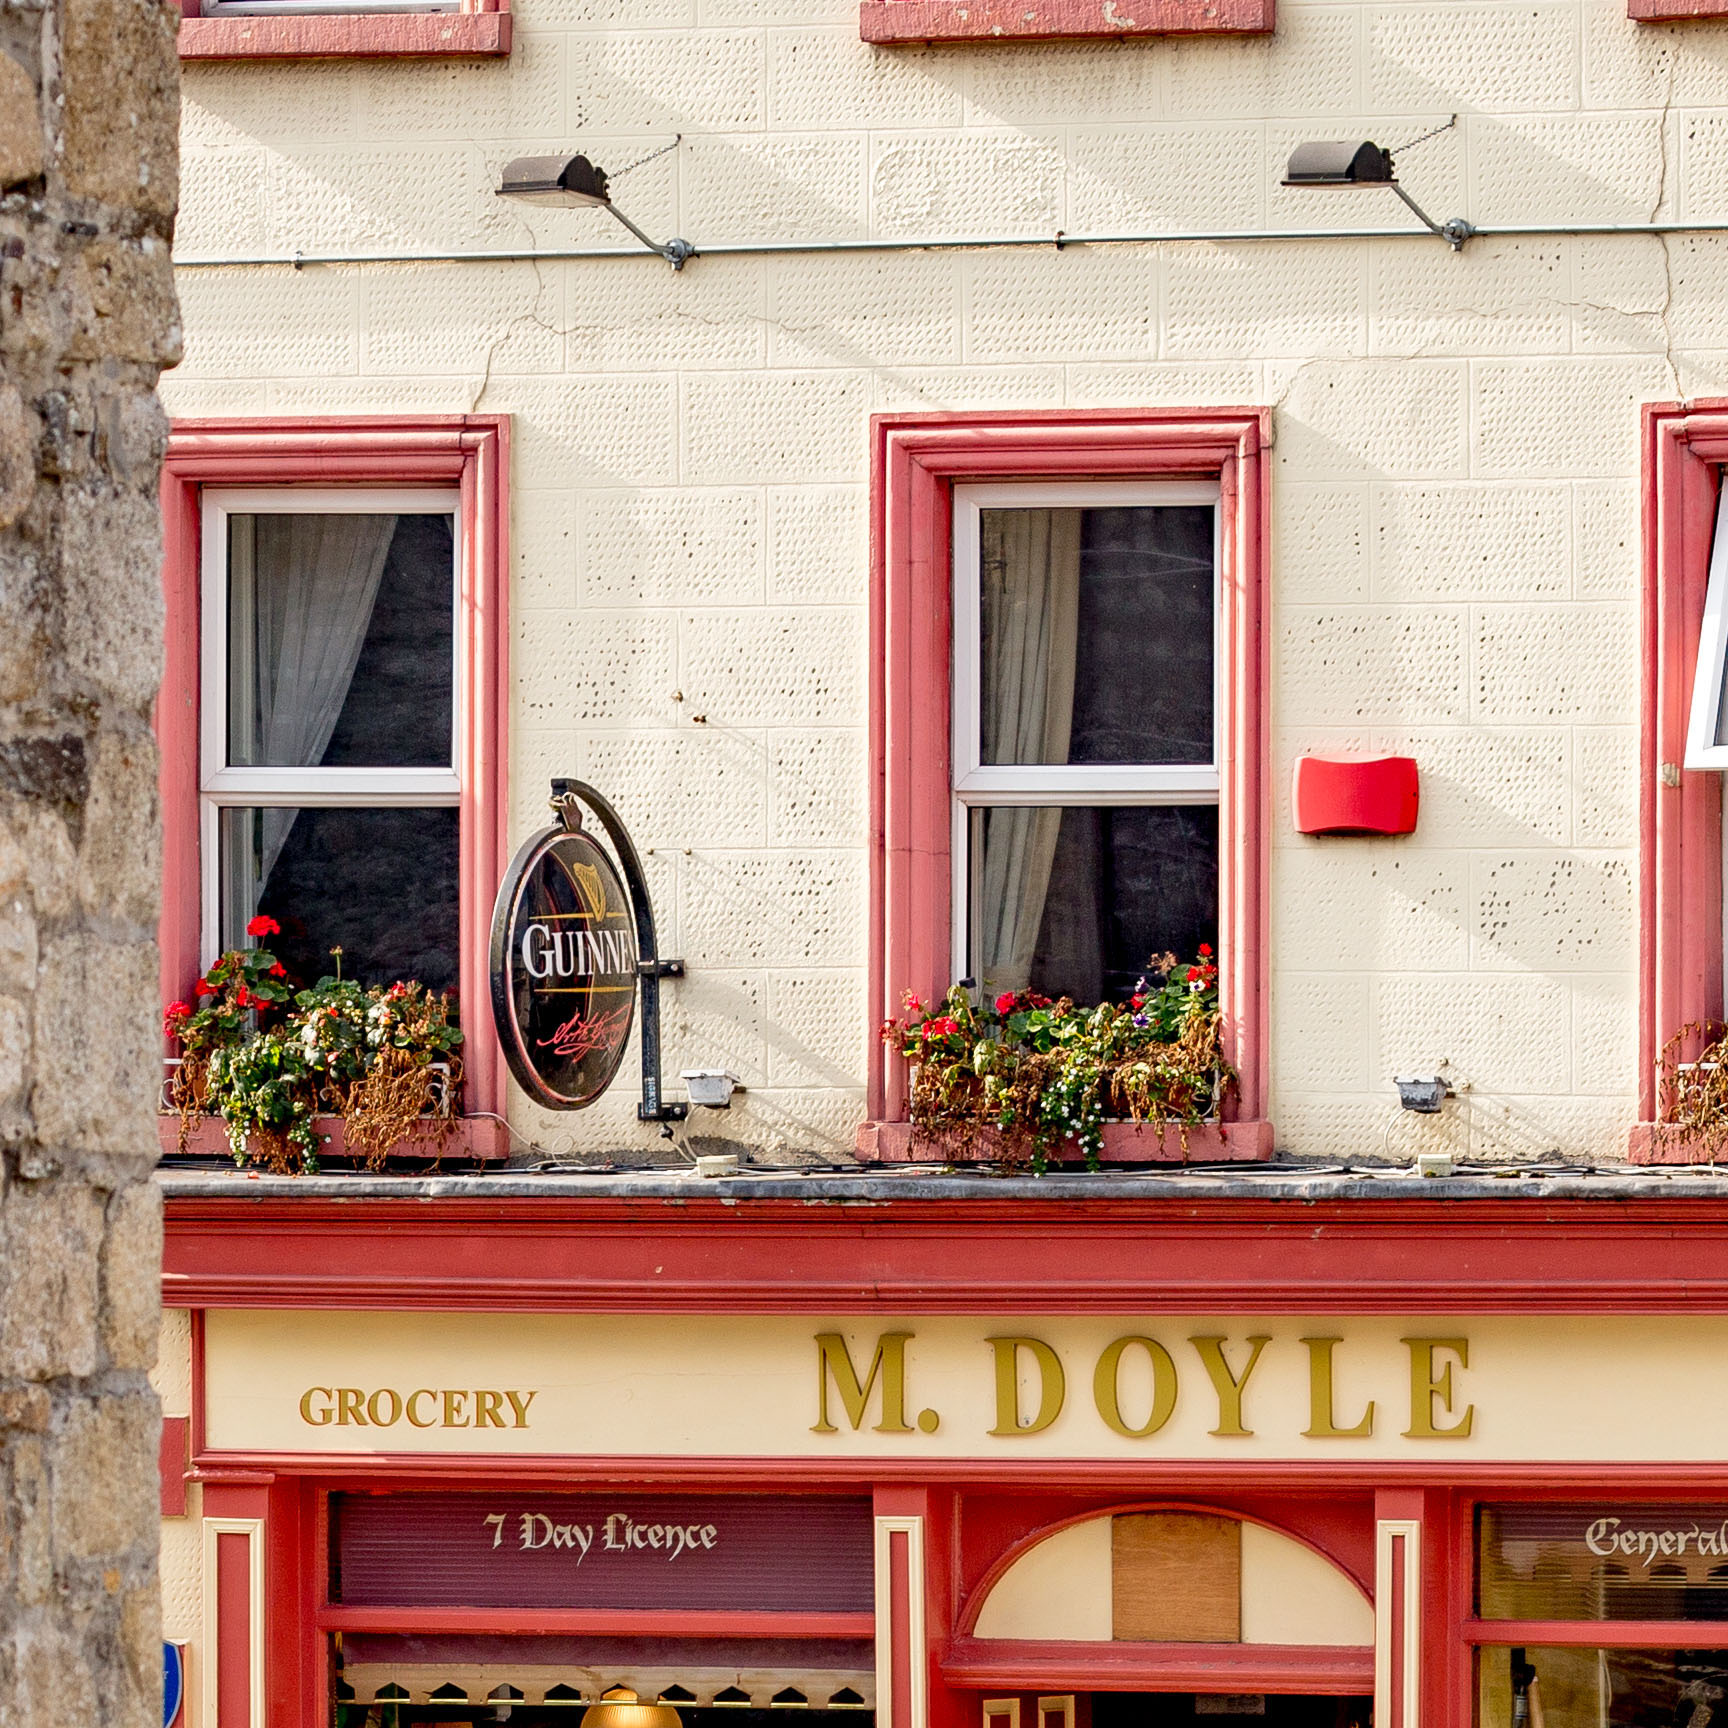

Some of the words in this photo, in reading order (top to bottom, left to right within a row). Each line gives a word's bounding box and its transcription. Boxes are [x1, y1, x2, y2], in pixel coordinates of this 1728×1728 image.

[300, 1387, 538, 1429] GROCERY
[809, 1332, 940, 1434] M.
[985, 1335, 1475, 1438] DOYLE
[483, 1513, 507, 1550] 7
[518, 1512, 594, 1566] Day
[602, 1512, 718, 1561] Licence
